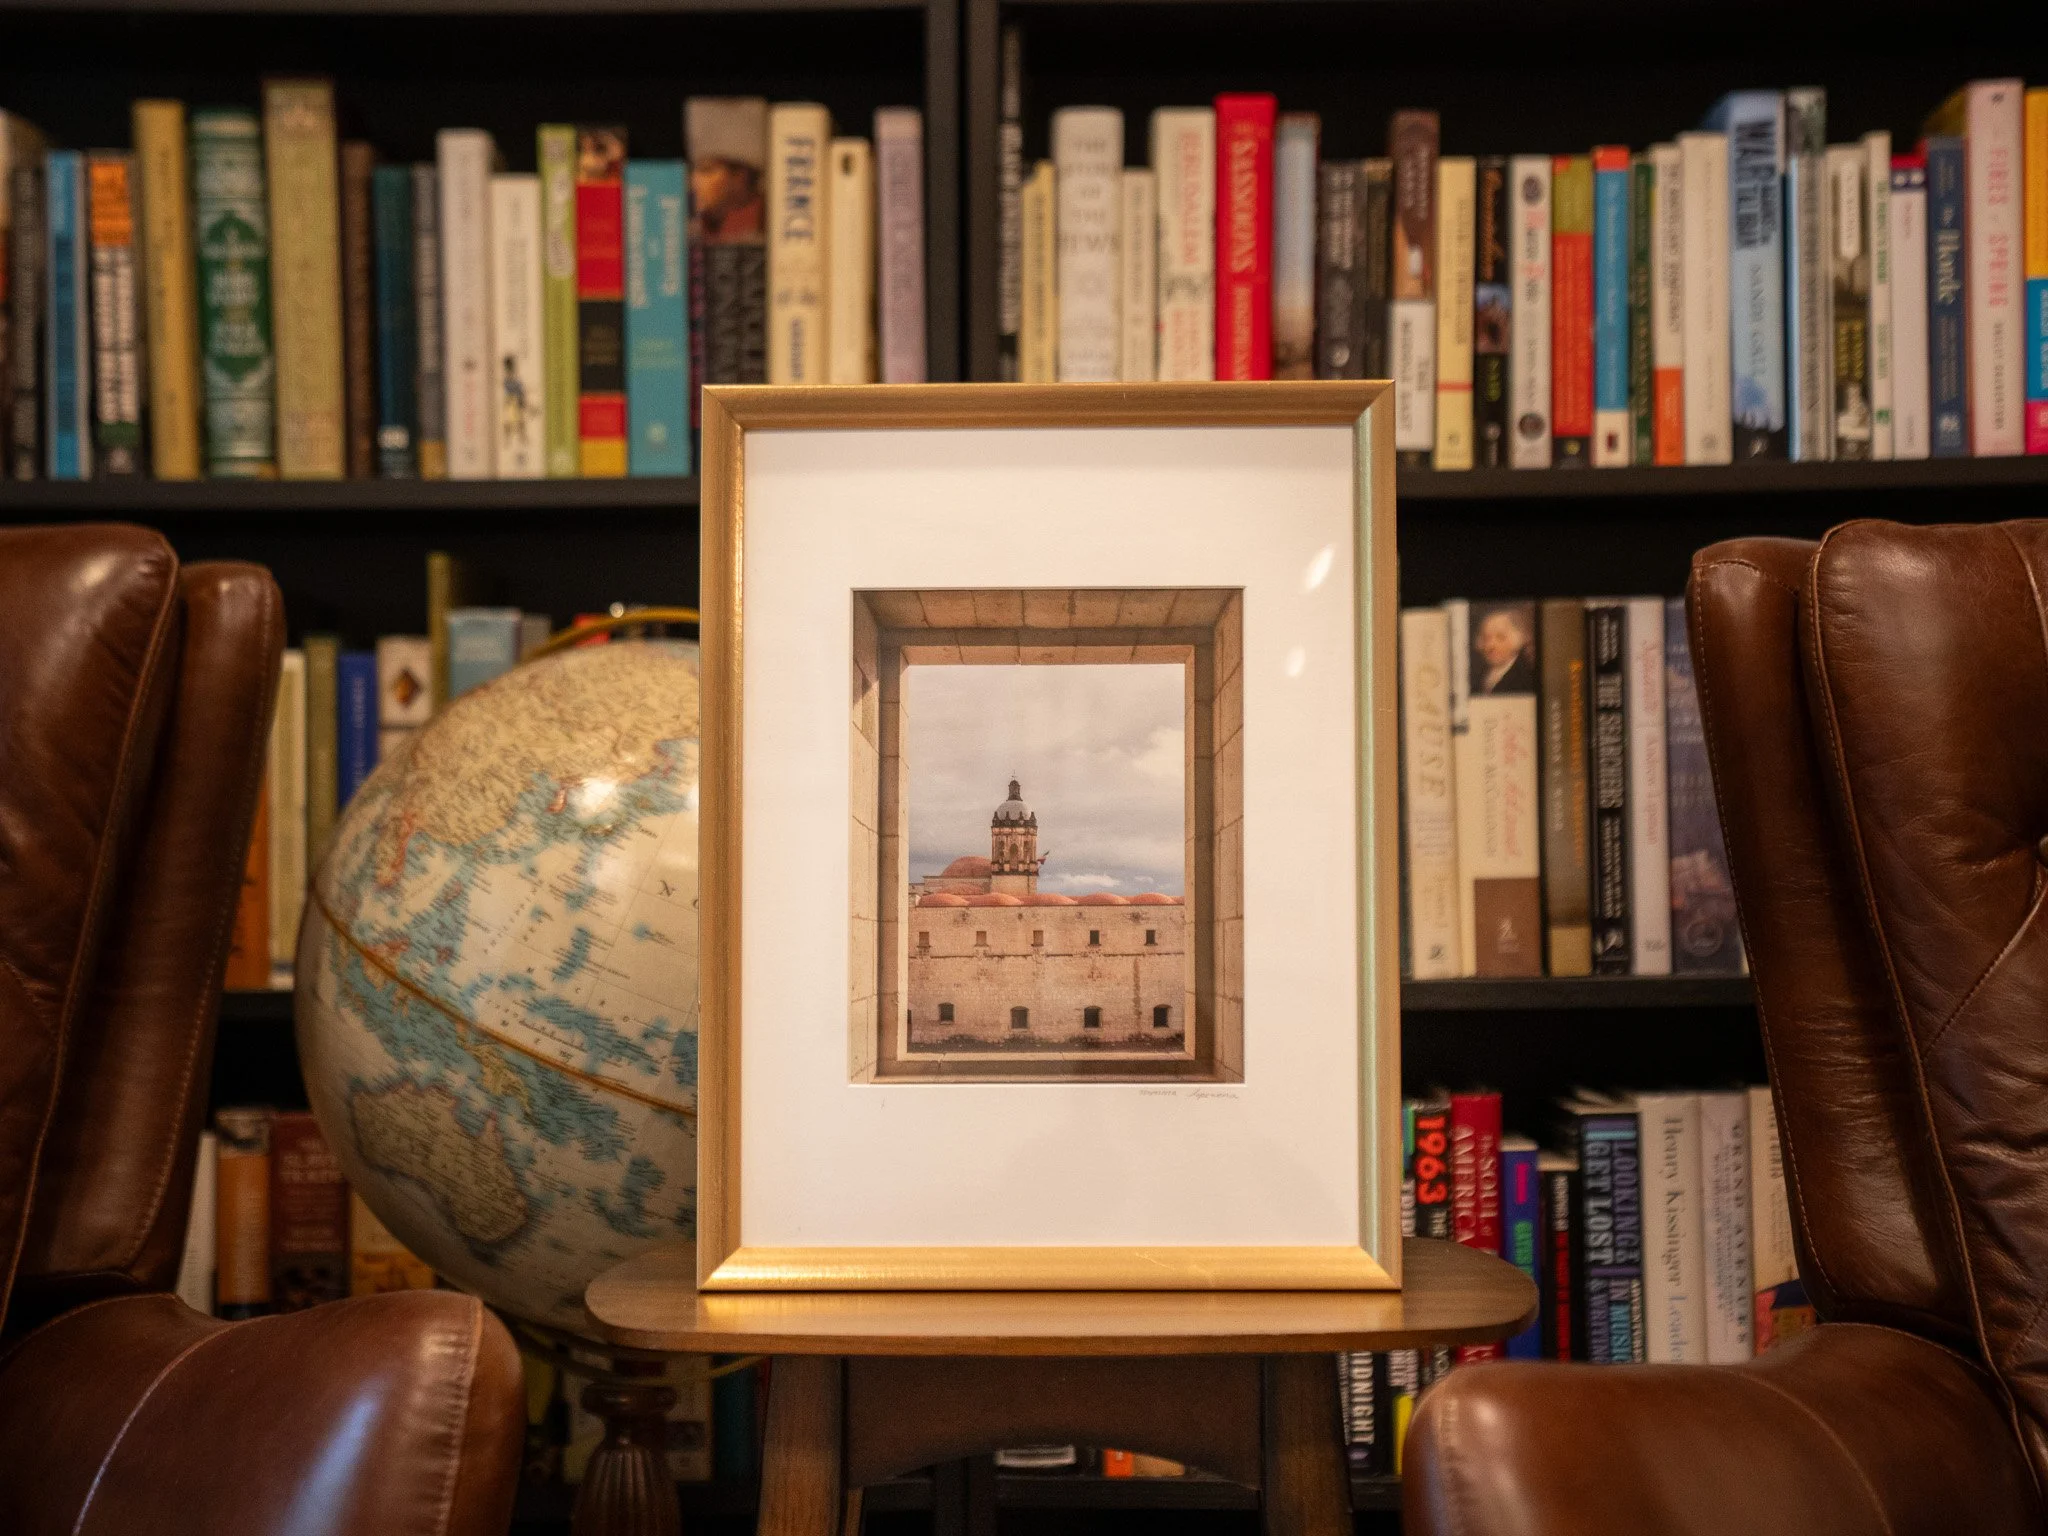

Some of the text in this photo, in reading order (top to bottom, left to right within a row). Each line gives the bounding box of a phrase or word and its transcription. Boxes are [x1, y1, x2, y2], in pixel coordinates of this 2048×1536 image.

[783, 136, 817, 243] FRANCE
[1734, 119, 1777, 185] WAR
[1936, 229, 1962, 306] Horde
[1598, 672, 1624, 810] THE SEARCHERS
[1416, 1113, 1448, 1205] 1963
[1451, 1123, 1478, 1243] AMERICA
[1479, 1155, 1499, 1219] SOUL
[1611, 1141, 1638, 1247] LOOKING
[1658, 1117, 1685, 1181] Henry
[1584, 1141, 1614, 1266] GET LOST
[1660, 1190, 1687, 1287] Kissinger
[1609, 1279, 1632, 1301] IN
